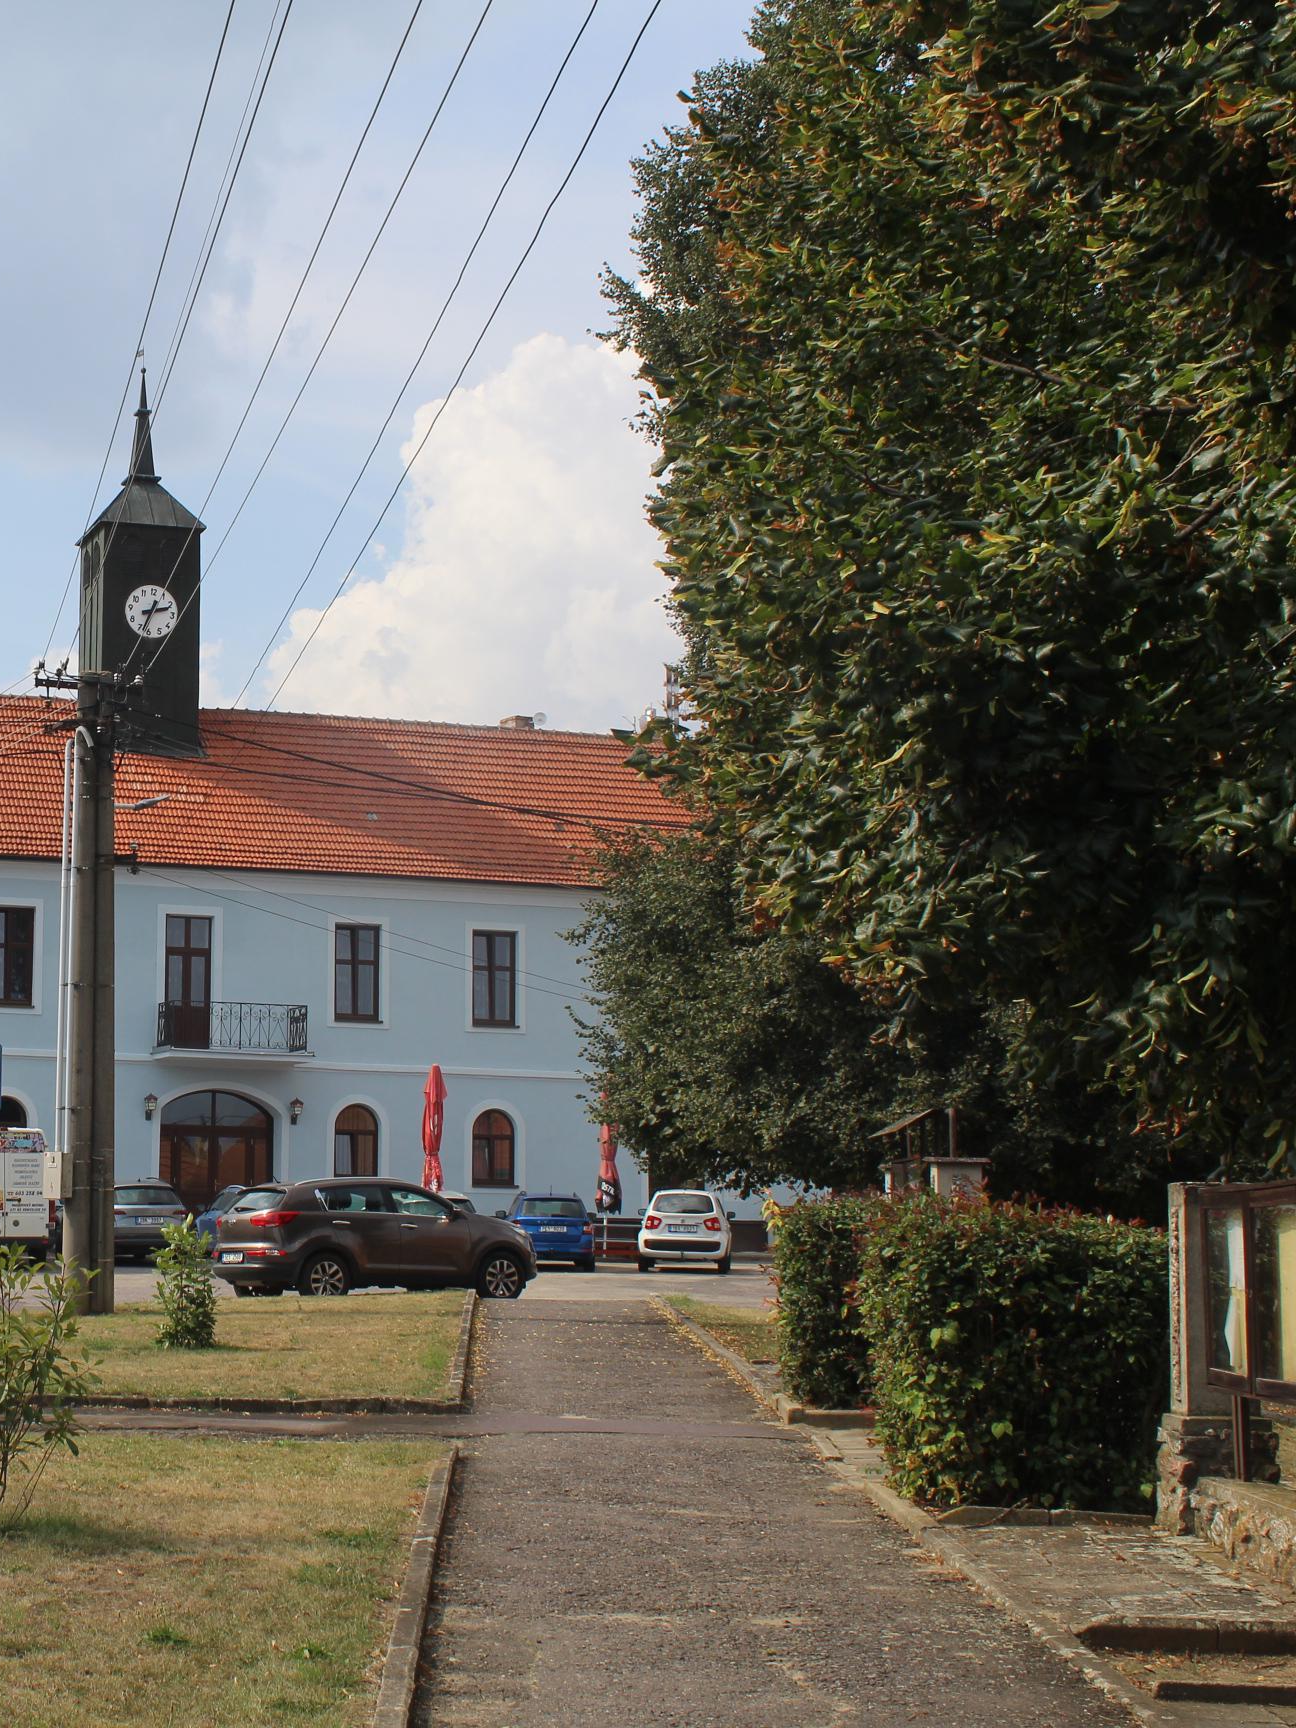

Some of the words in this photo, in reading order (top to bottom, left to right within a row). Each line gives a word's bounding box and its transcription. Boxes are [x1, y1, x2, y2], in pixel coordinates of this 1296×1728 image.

[151, 588, 157, 596] 12
[133, 595, 139, 603] 10
[146, 628, 151, 636] 6
